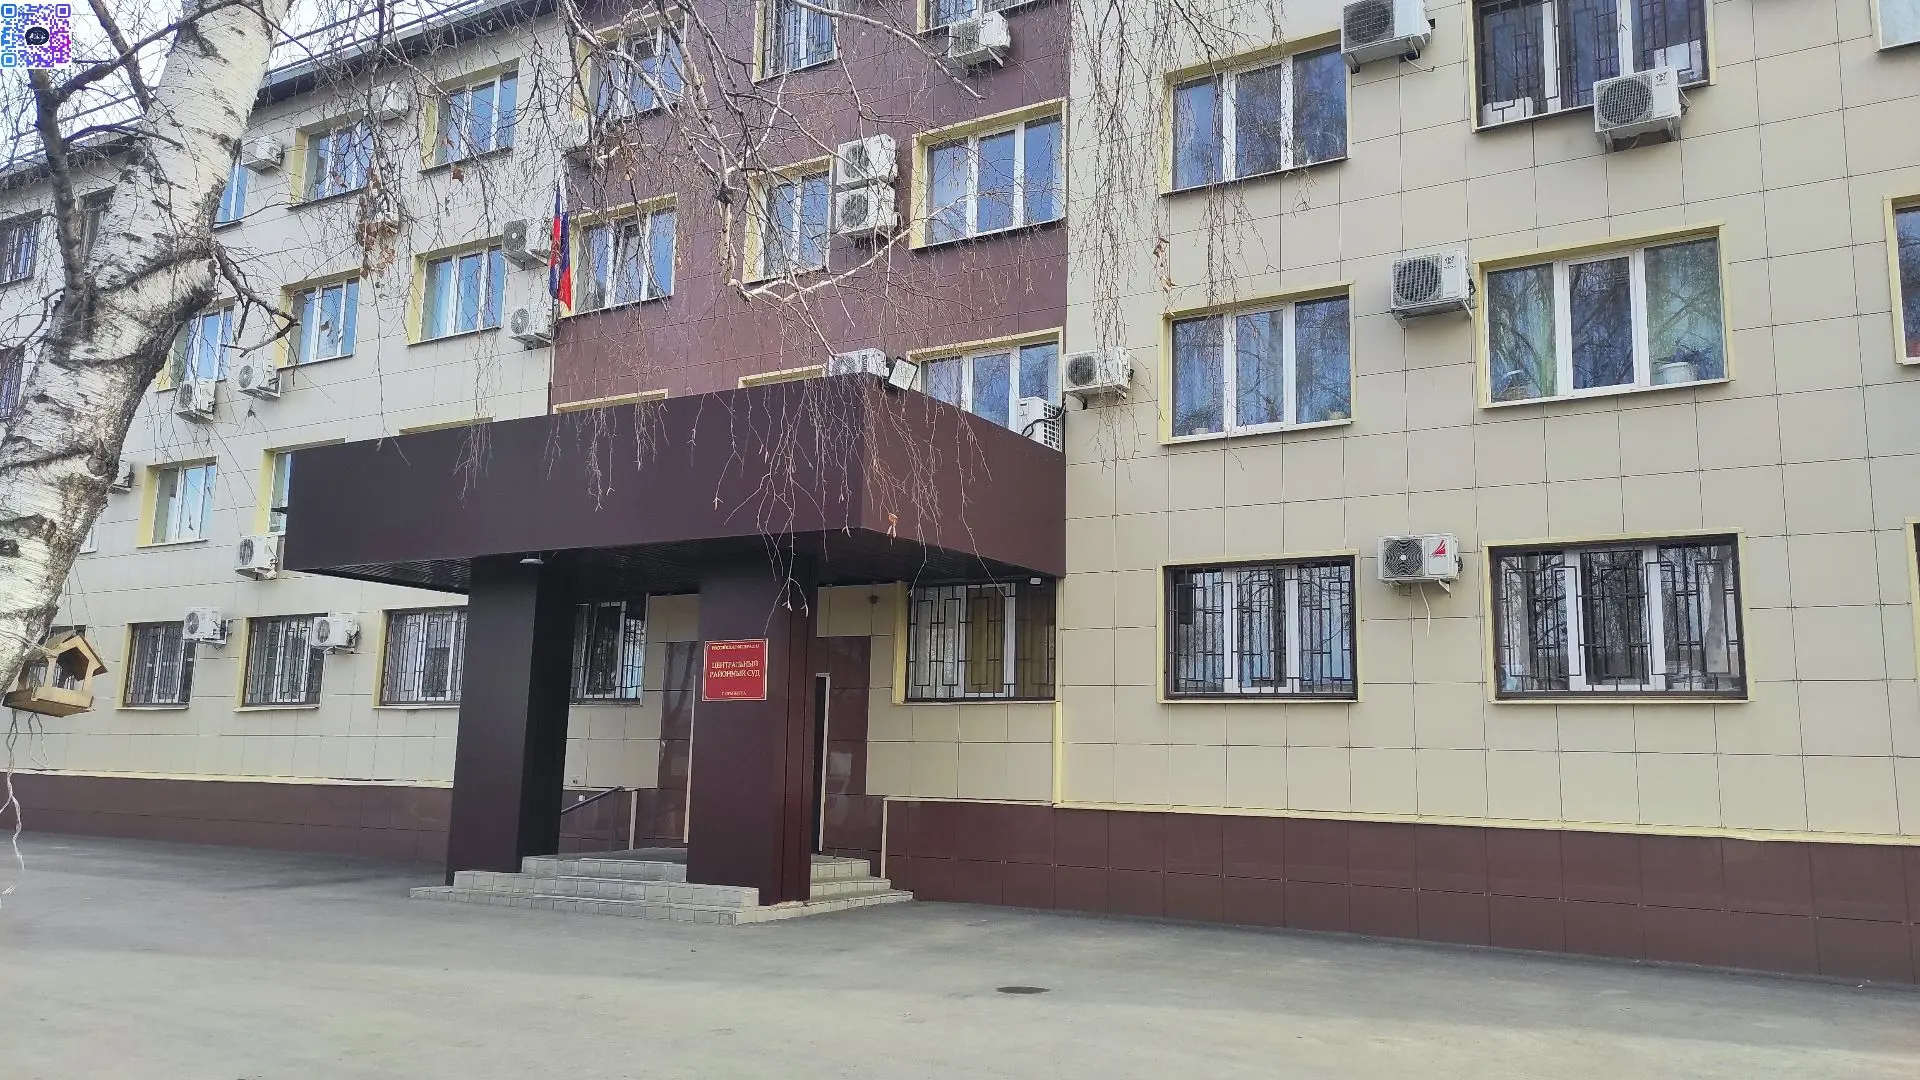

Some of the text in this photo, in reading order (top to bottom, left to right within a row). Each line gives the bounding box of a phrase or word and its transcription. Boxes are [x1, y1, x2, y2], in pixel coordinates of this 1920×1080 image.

[711, 660, 759, 669] ЦЕНТРАЛЬНЫЙ
[709, 669, 761, 678] РАЙОННЫЙ СУД
